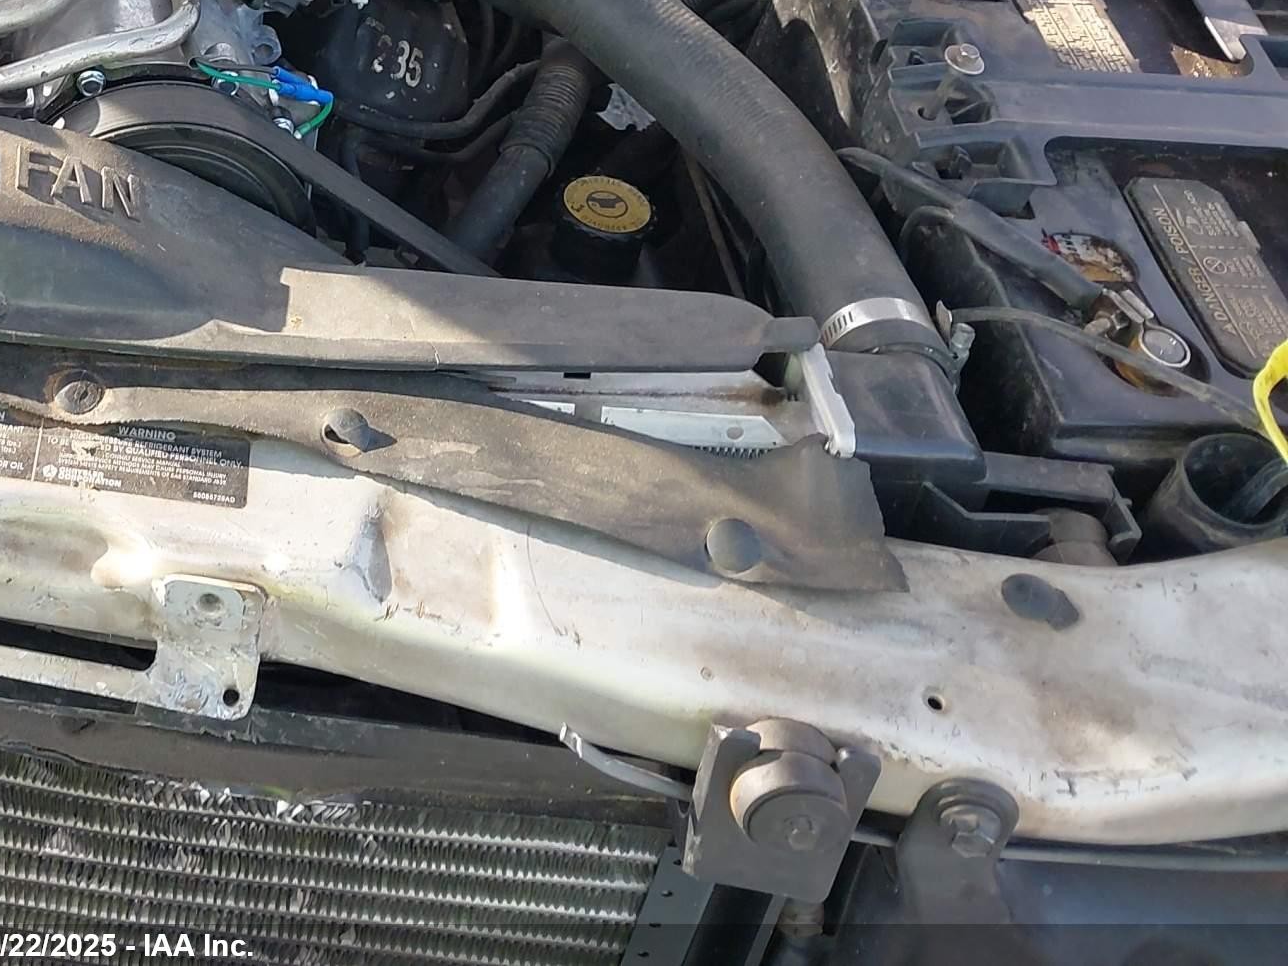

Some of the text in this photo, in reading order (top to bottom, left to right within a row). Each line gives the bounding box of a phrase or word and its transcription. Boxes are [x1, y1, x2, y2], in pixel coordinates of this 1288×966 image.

[15, 144, 143, 221] FAN
[1153, 207, 1190, 254] POISON
[118, 425, 176, 442] WARNING
[9, 461, 25, 471] OIL
